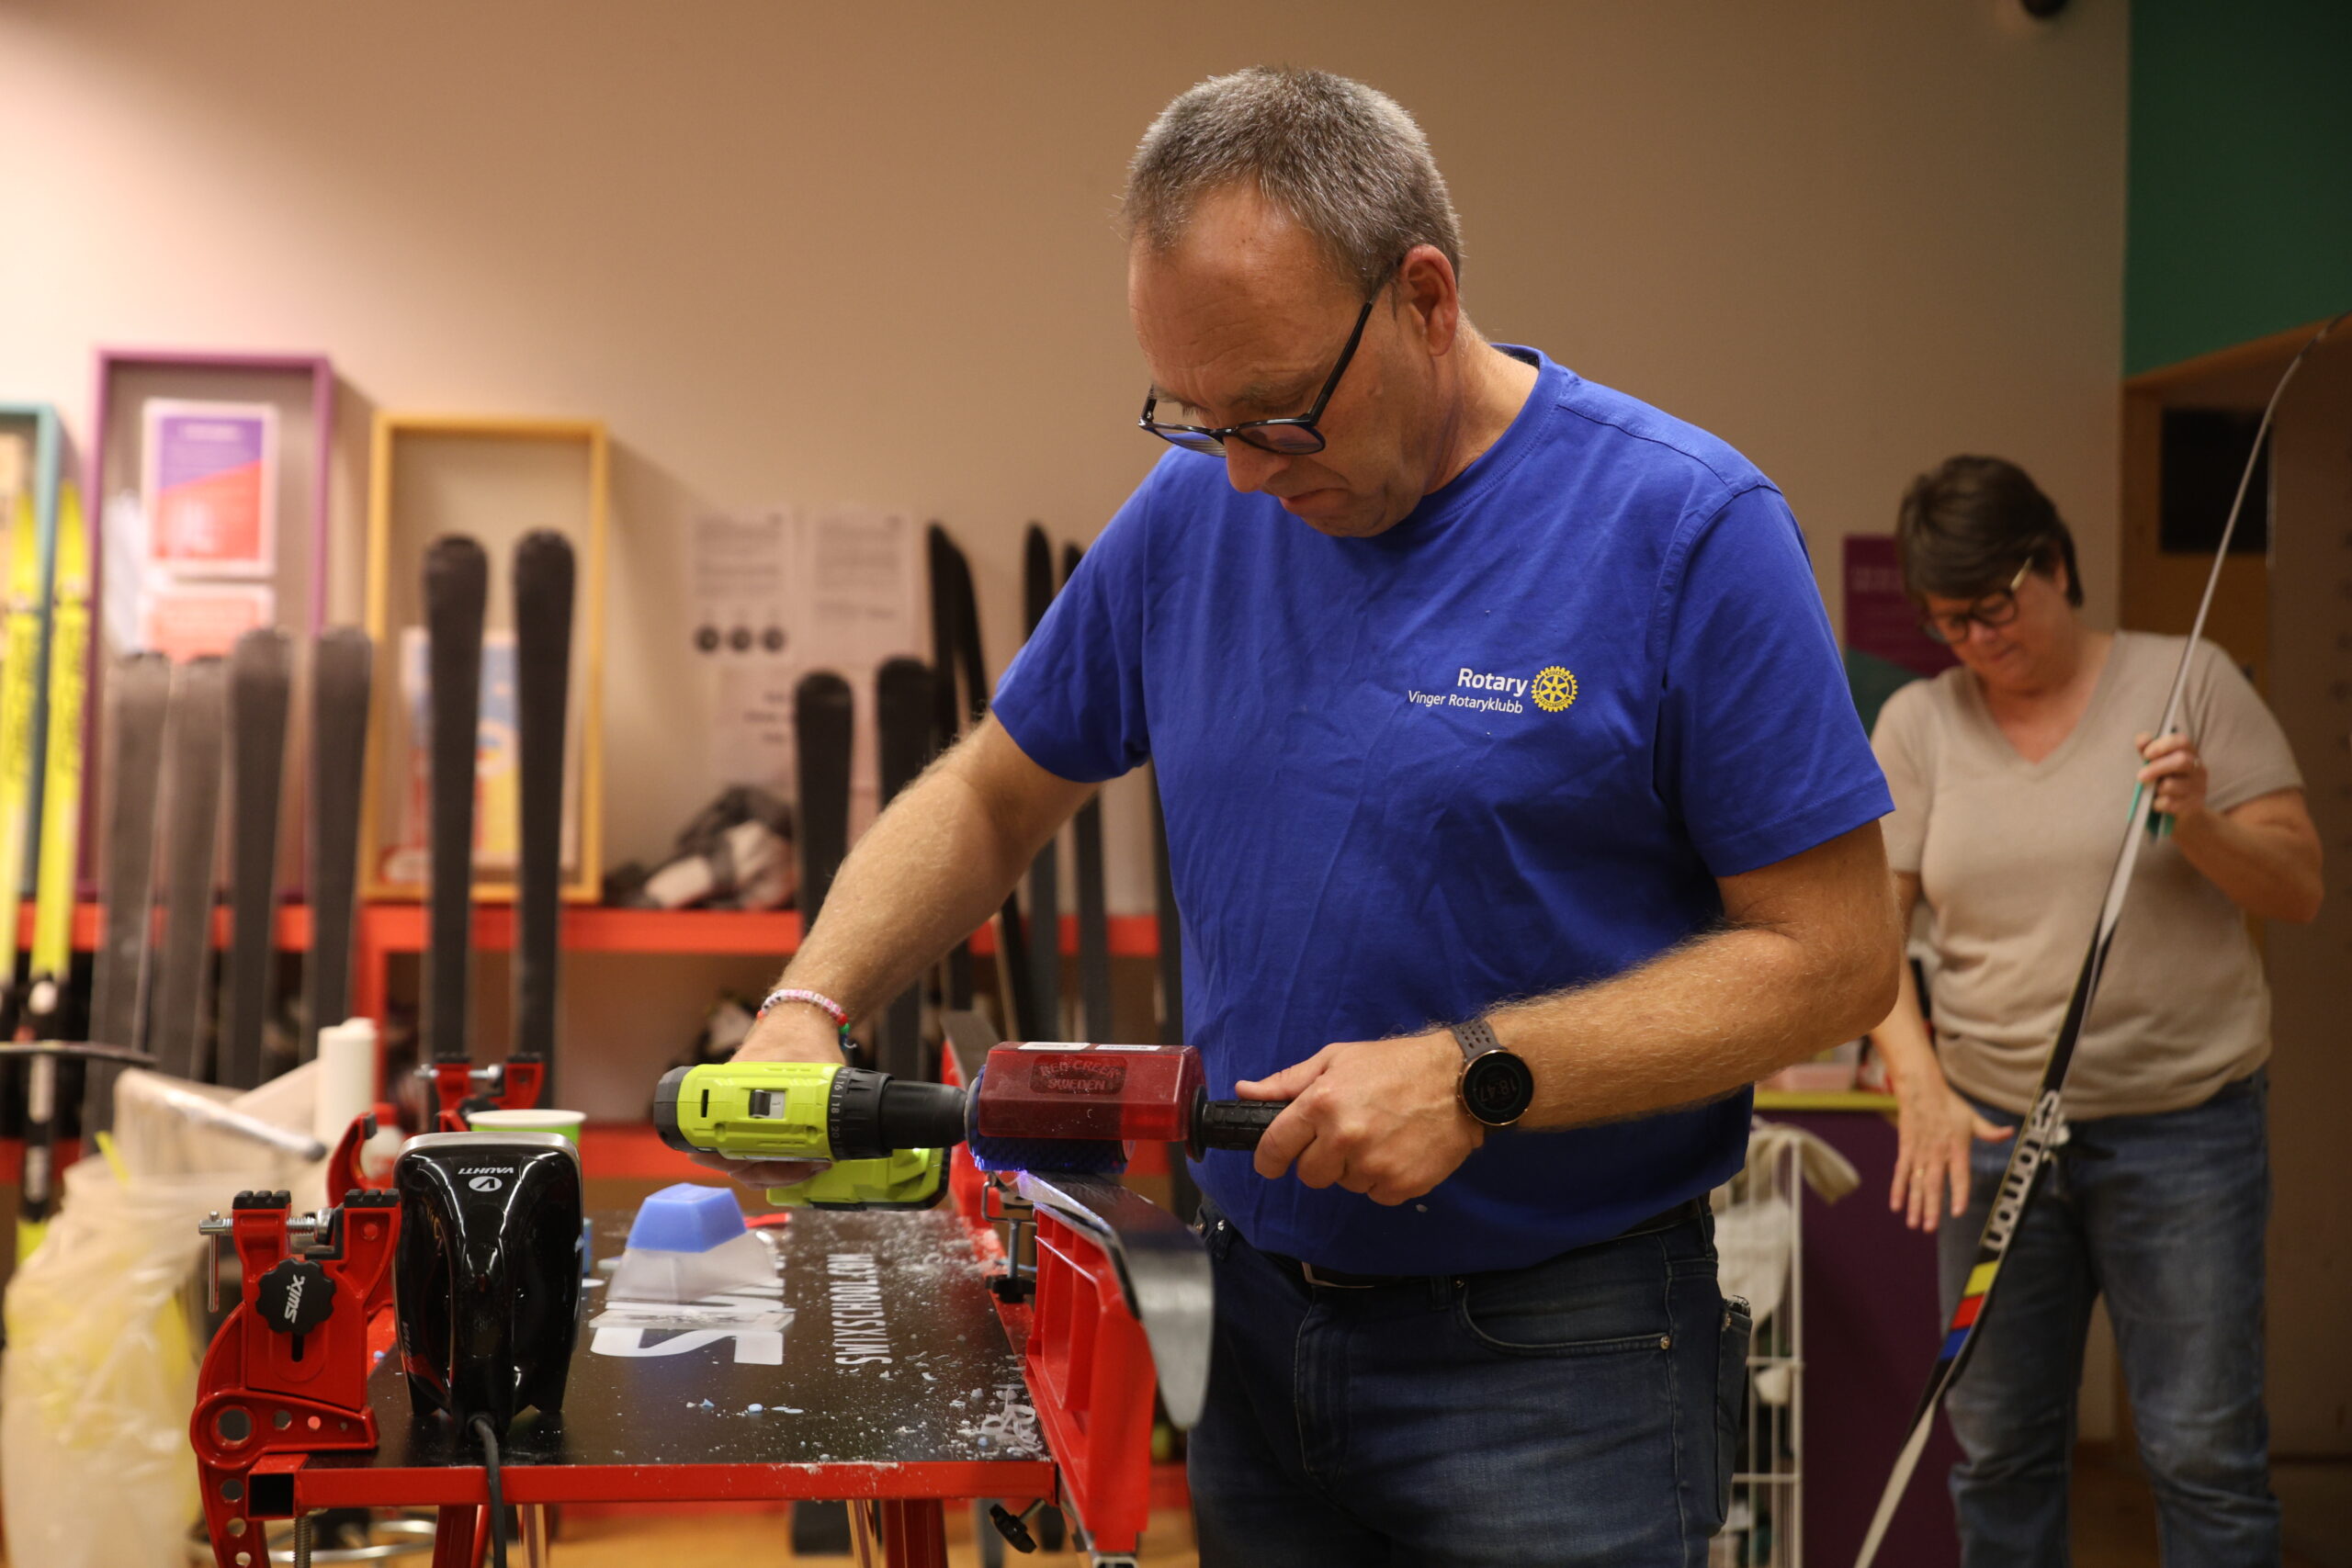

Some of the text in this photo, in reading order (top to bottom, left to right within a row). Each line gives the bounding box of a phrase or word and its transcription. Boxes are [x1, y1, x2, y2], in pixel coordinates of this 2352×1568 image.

[1457, 668, 1528, 697] Rotary
[1408, 690, 1446, 707] Vinger
[1449, 694, 1523, 714] Rotaryklubb
[834, 1081, 844, 1090] 16
[1047, 1078, 1106, 1091] SWEDEN
[831, 1102, 841, 1114] 18
[831, 1126, 840, 1139] 20
[458, 1167, 514, 1175] VAUHTI
[826, 1253, 893, 1365] SWIXSCHOOL.COM
